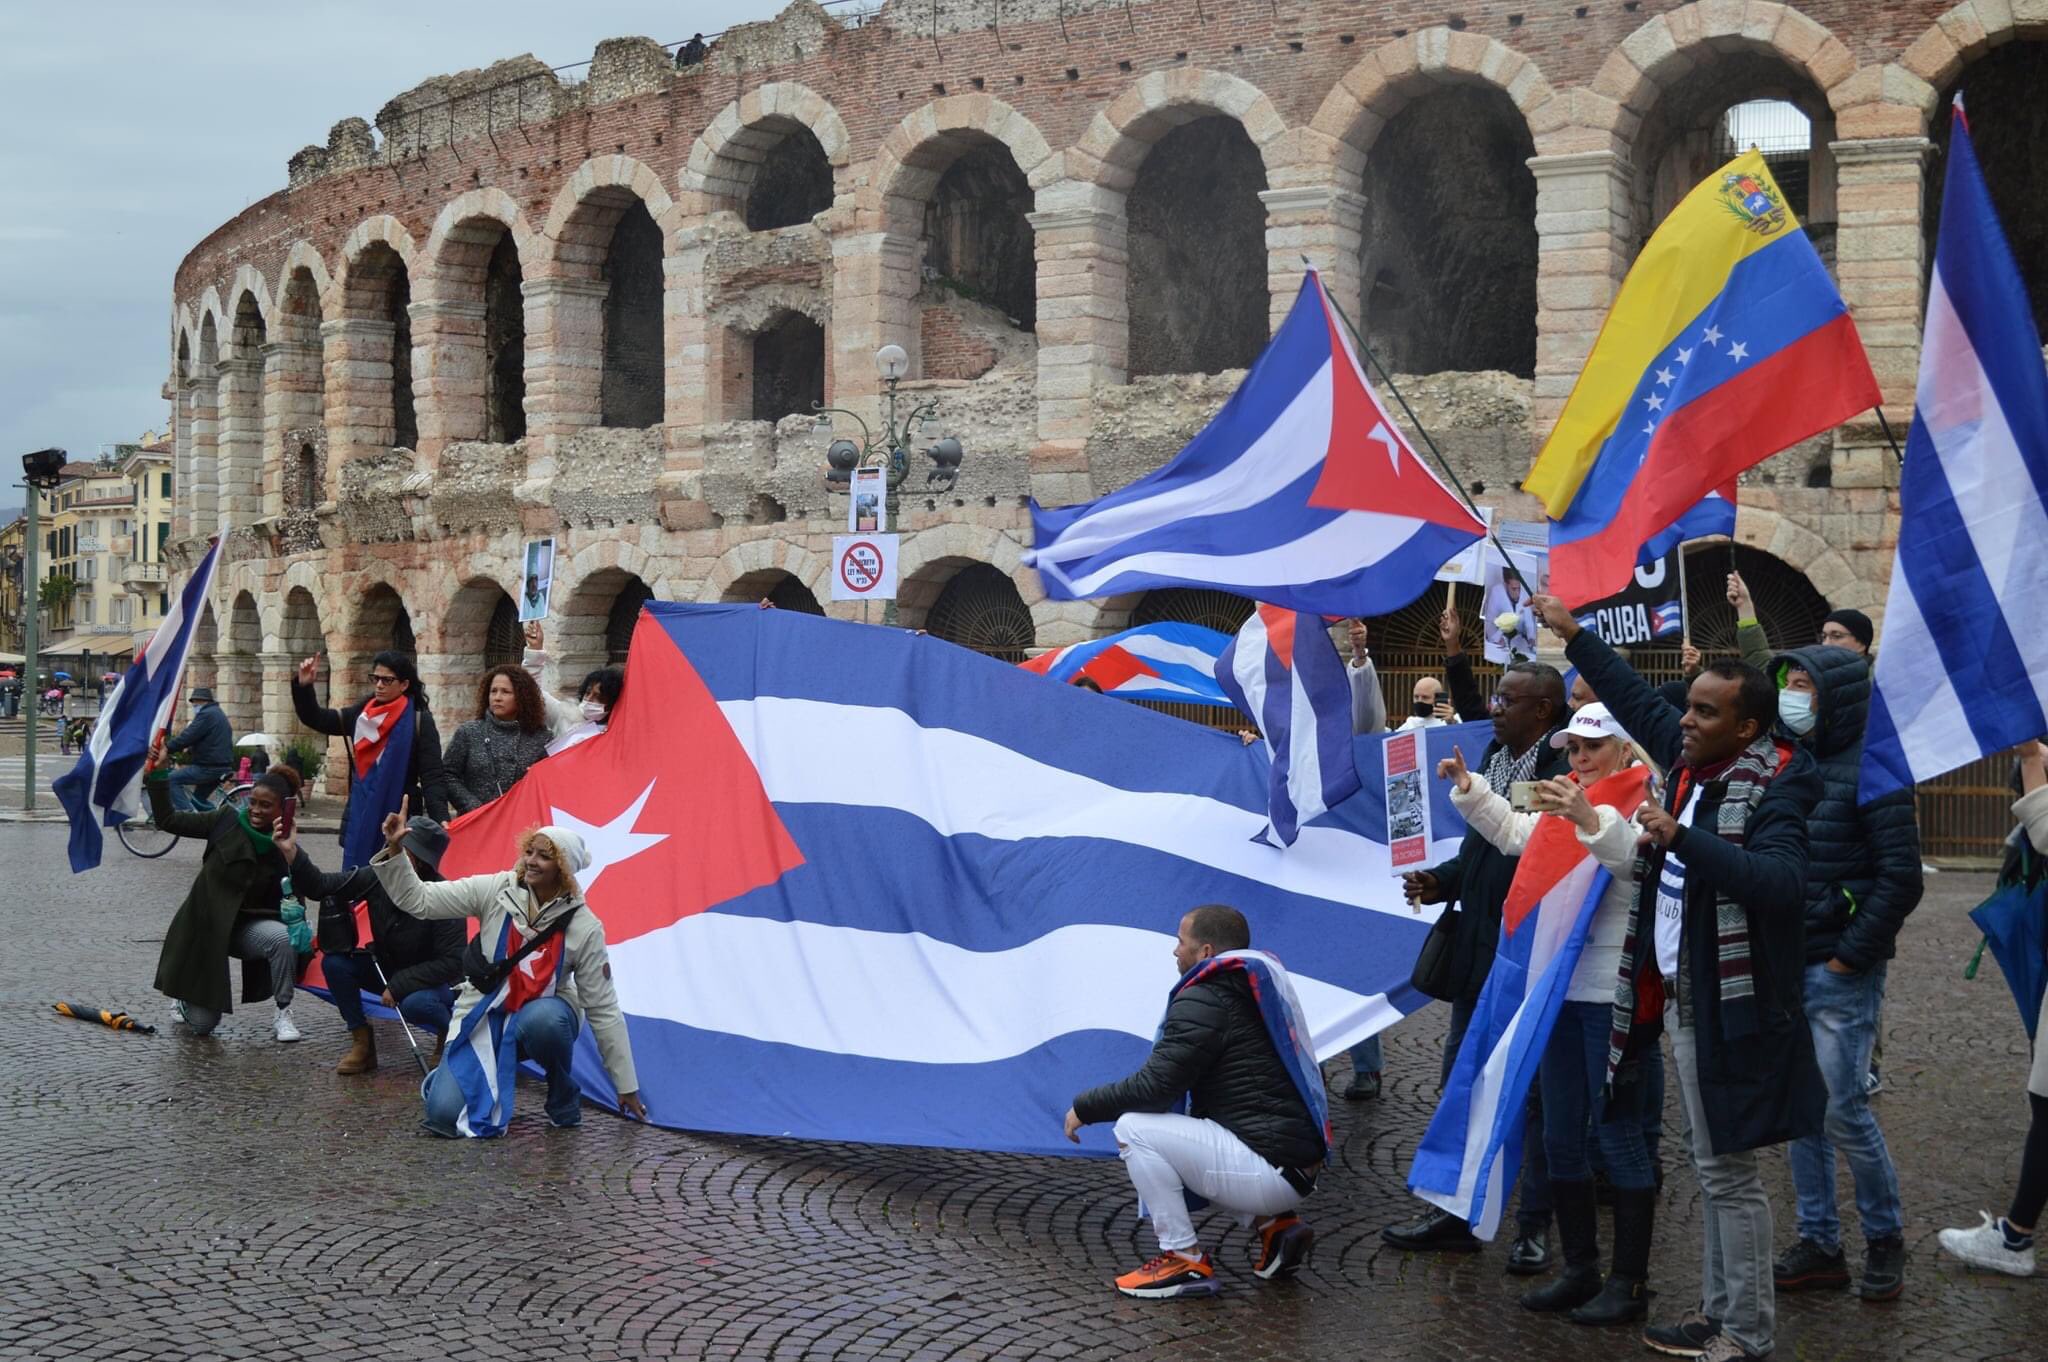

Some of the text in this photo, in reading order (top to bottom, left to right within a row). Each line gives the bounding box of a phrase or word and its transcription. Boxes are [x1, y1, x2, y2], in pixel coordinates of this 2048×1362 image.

[847, 568, 855, 576] LEY
[1597, 603, 1651, 645] CUBA
[1576, 716, 1601, 728] VIDA
